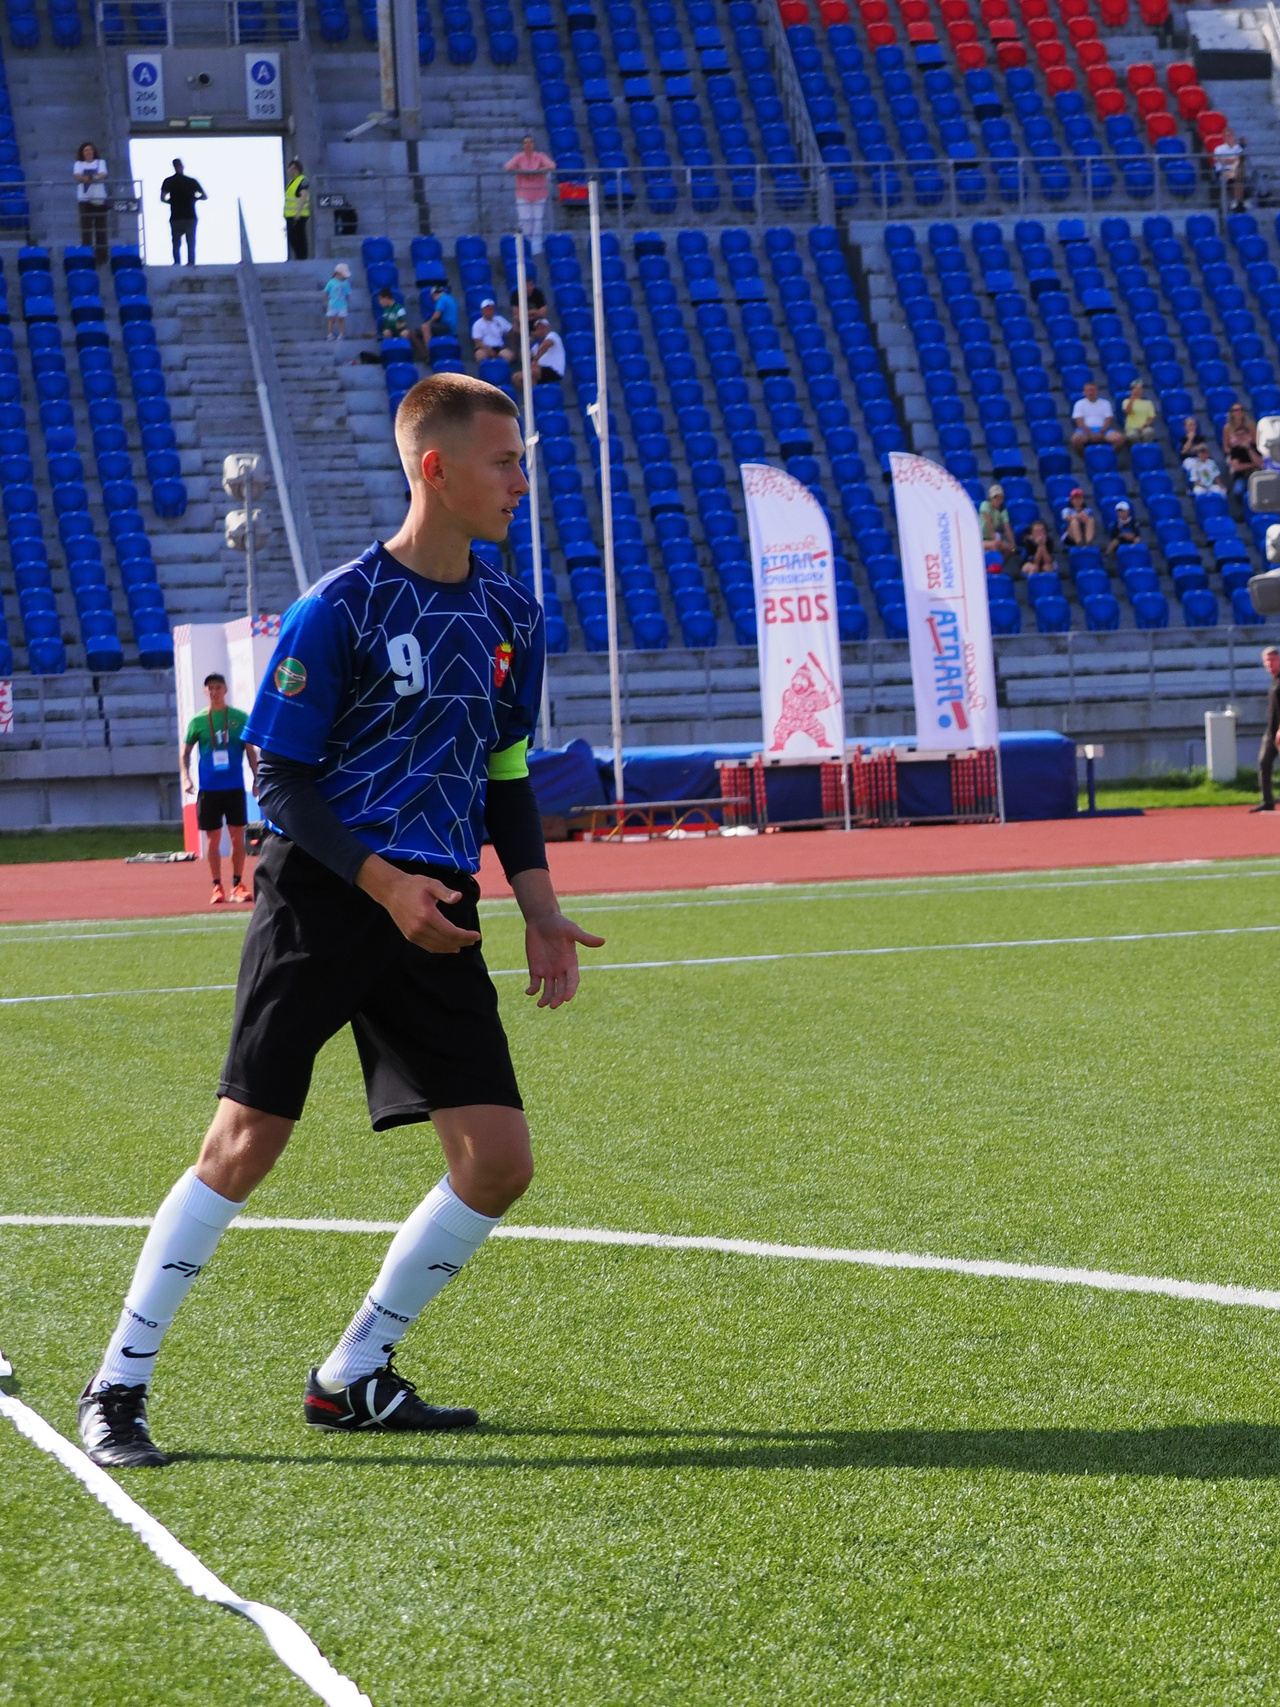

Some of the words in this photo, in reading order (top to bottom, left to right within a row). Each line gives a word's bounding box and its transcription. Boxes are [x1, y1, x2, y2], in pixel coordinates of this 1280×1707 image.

[135, 91, 158, 102] 206
[254, 88, 276, 100] 205
[136, 105, 158, 116] 104
[255, 103, 276, 115] 103
[387, 633, 426, 697] 9
